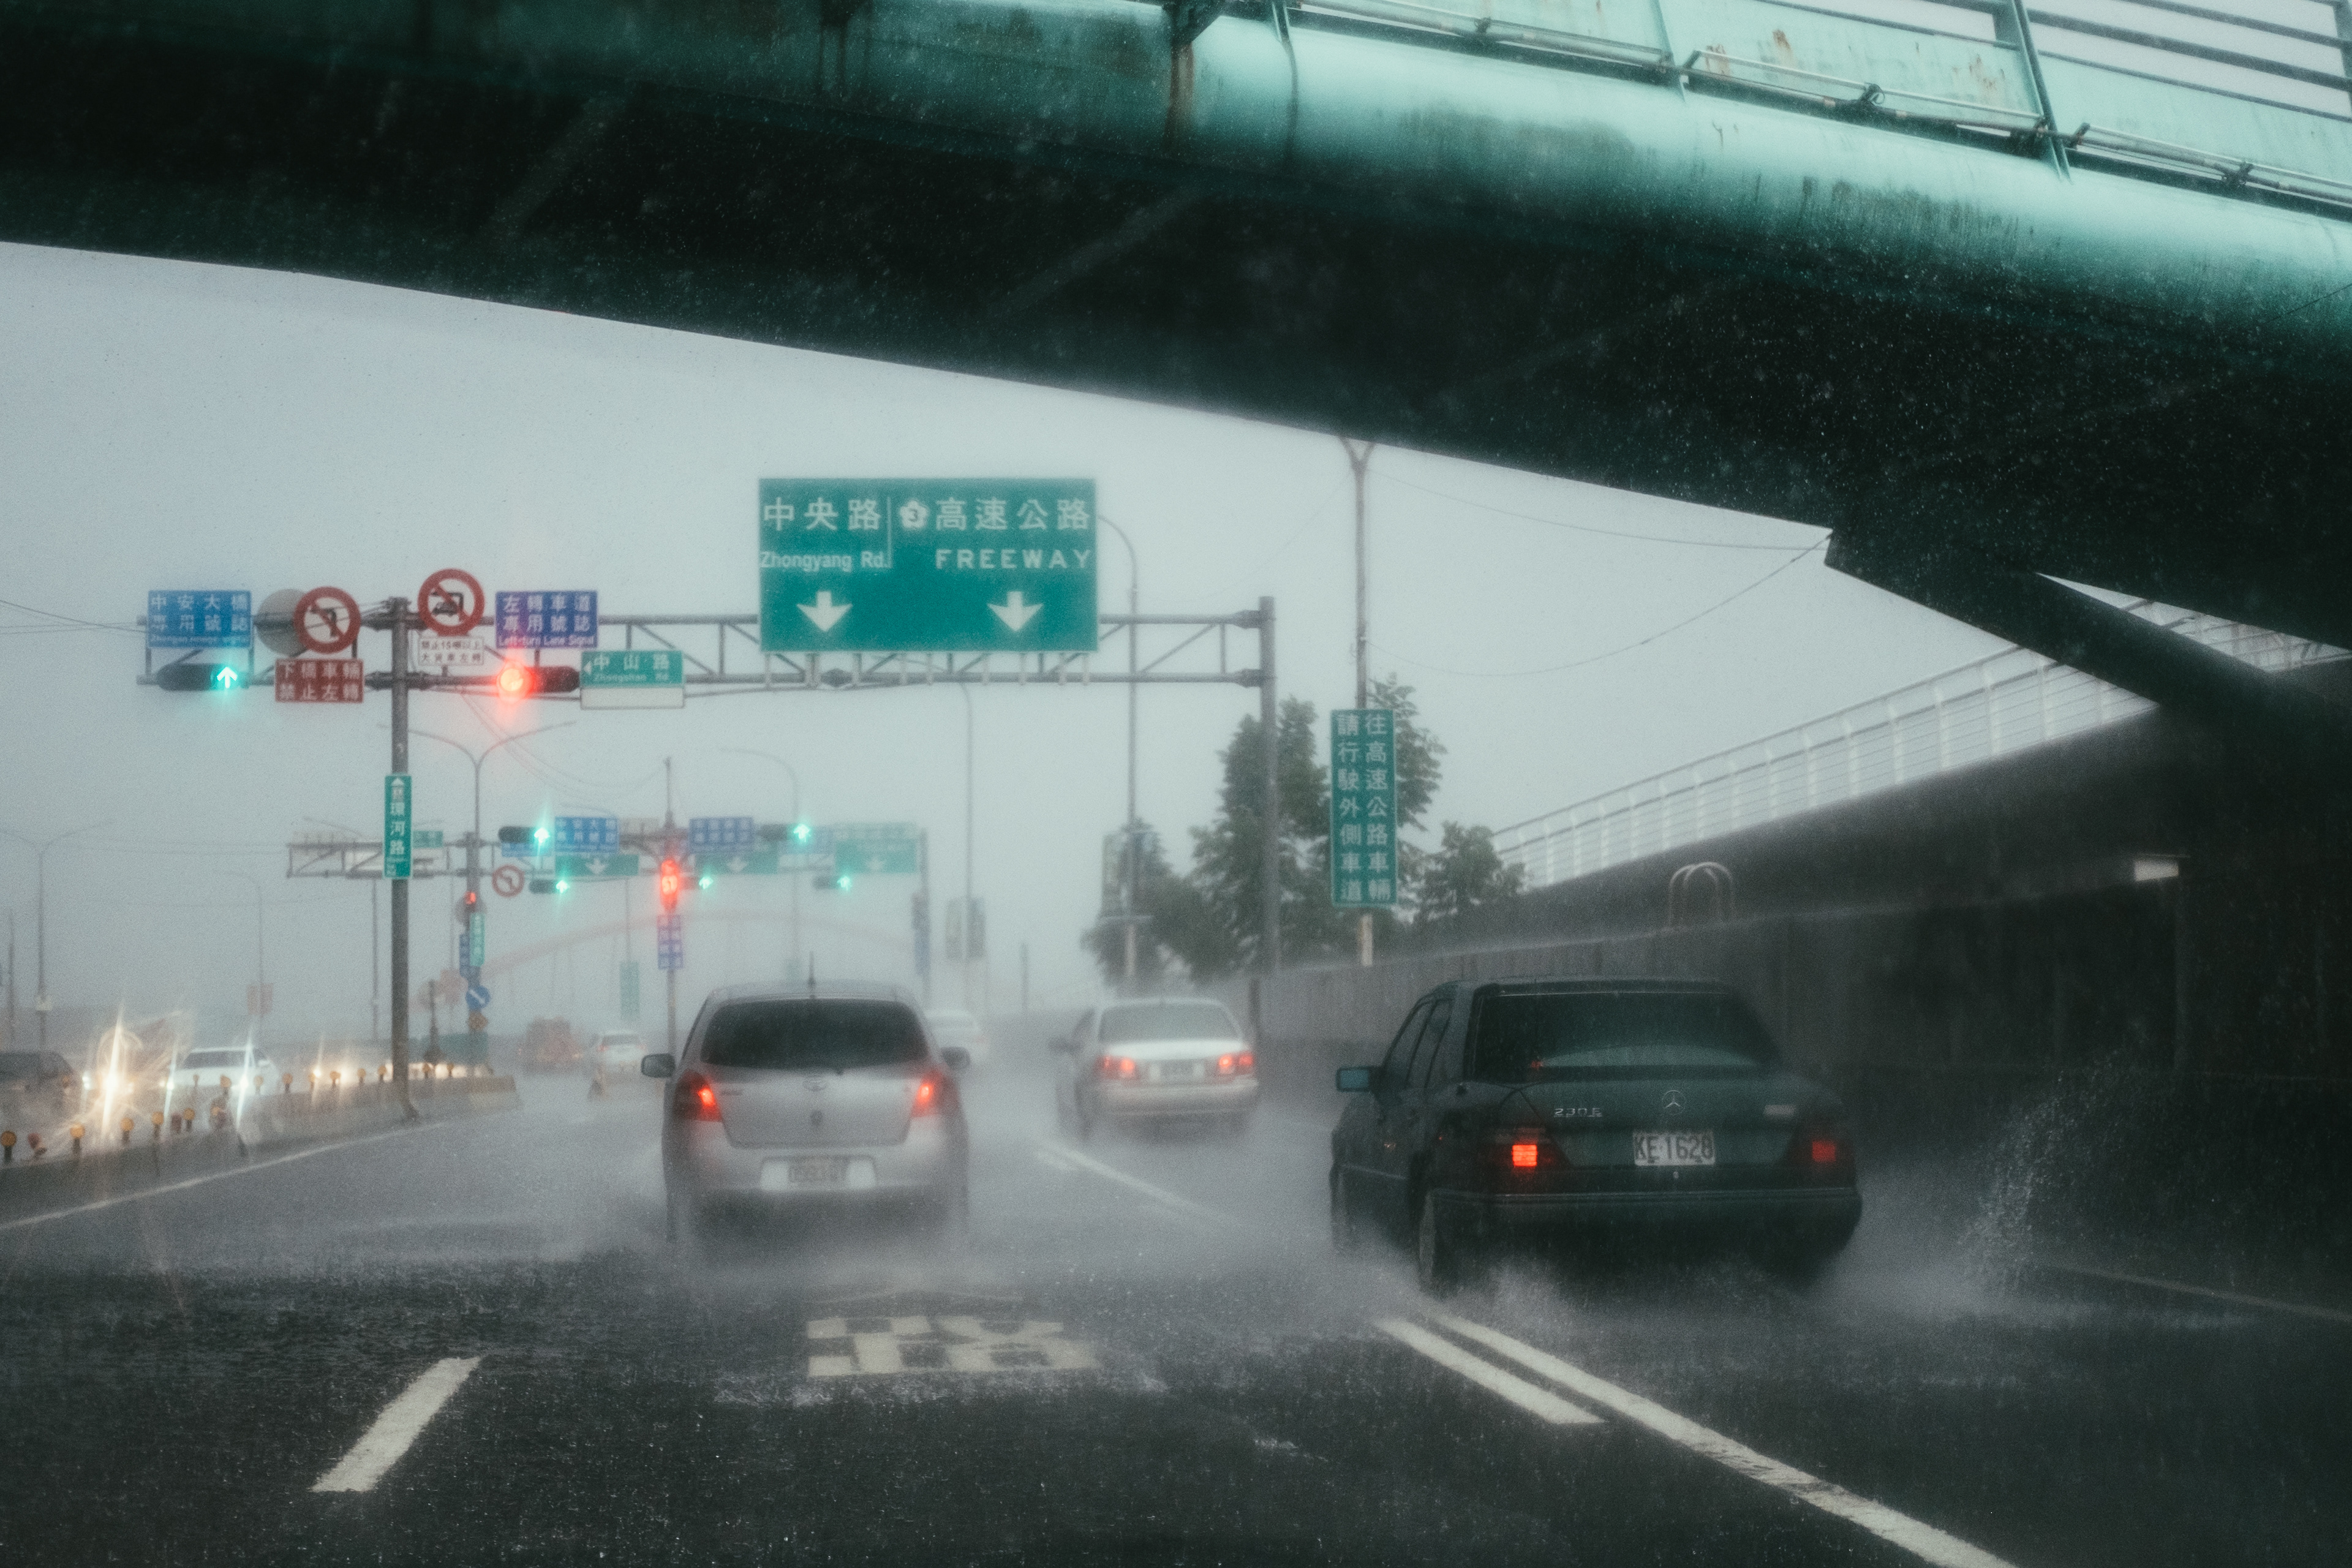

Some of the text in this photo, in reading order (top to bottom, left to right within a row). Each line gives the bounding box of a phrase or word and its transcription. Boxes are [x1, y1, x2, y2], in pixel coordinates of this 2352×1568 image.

[763, 497, 881, 531] 中央路
[907, 508, 918, 522] 3
[935, 497, 1090, 531] 高速公路
[760, 551, 852, 572] Zhongyang
[935, 549, 1091, 570] FREEWAY
[594, 653, 669, 671] 中山路
